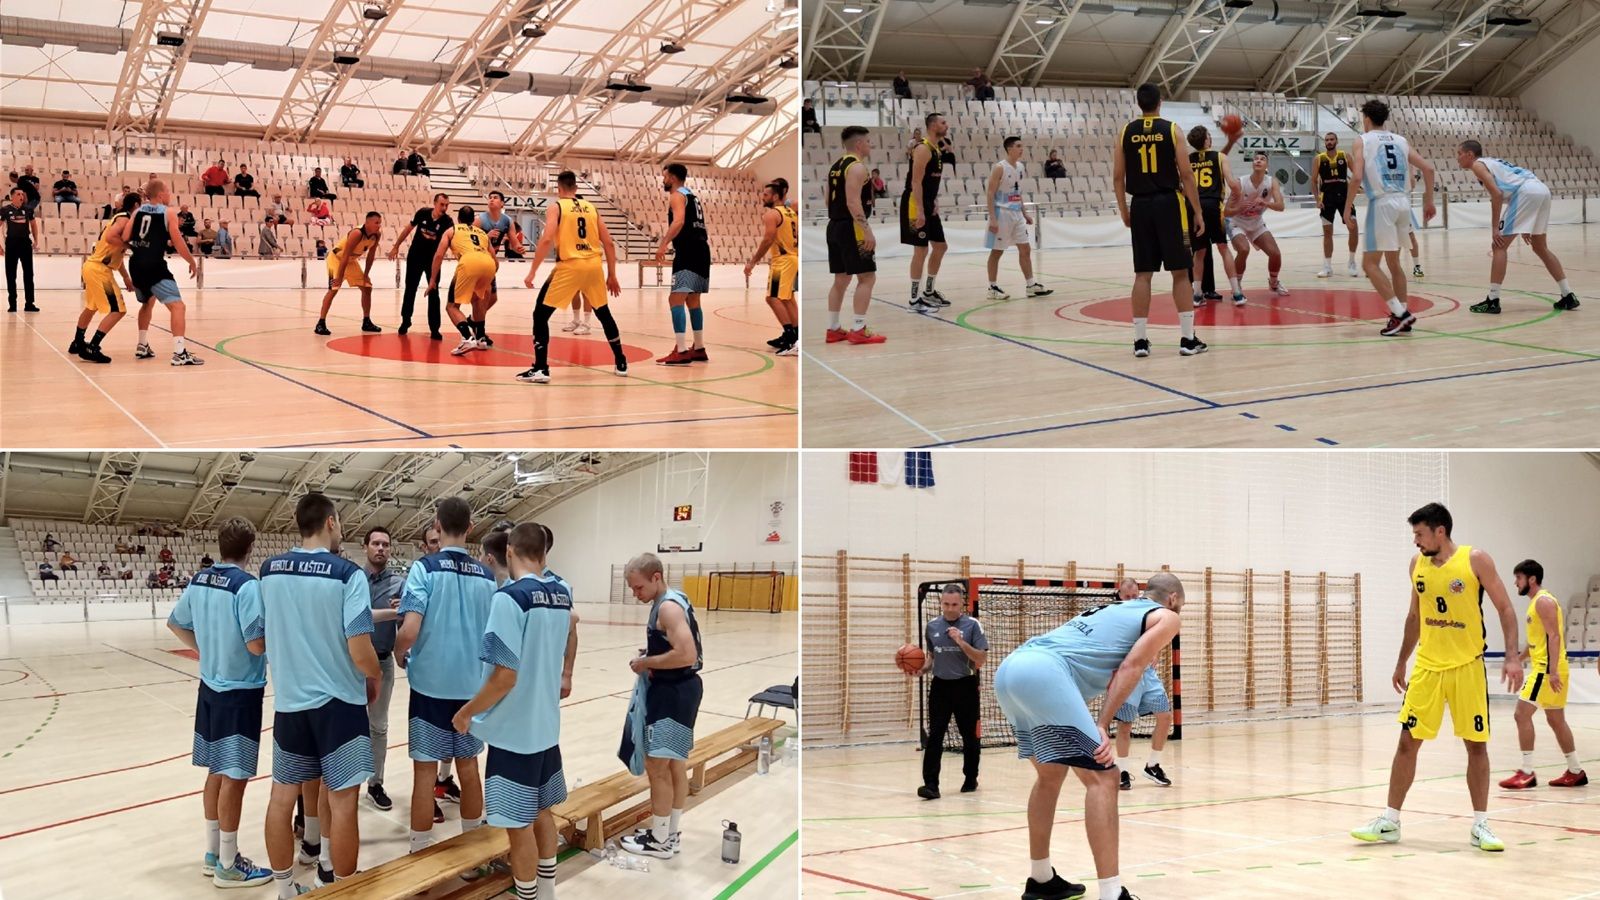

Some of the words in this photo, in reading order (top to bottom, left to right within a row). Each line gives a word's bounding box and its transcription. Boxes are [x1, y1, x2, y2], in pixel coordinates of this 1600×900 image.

[1131, 133, 1164, 143] OMIŠ
[1243, 137, 1300, 148] IZLAZ
[1138, 143, 1157, 173] 11
[1384, 144, 1397, 170] 5
[139, 215, 151, 239] 0
[577, 217, 587, 239] 8
[470, 234, 480, 246] 9
[298, 560, 332, 575] KAŠTELA
[1436, 596, 1448, 613] 8
[1474, 715, 1484, 732] 8
